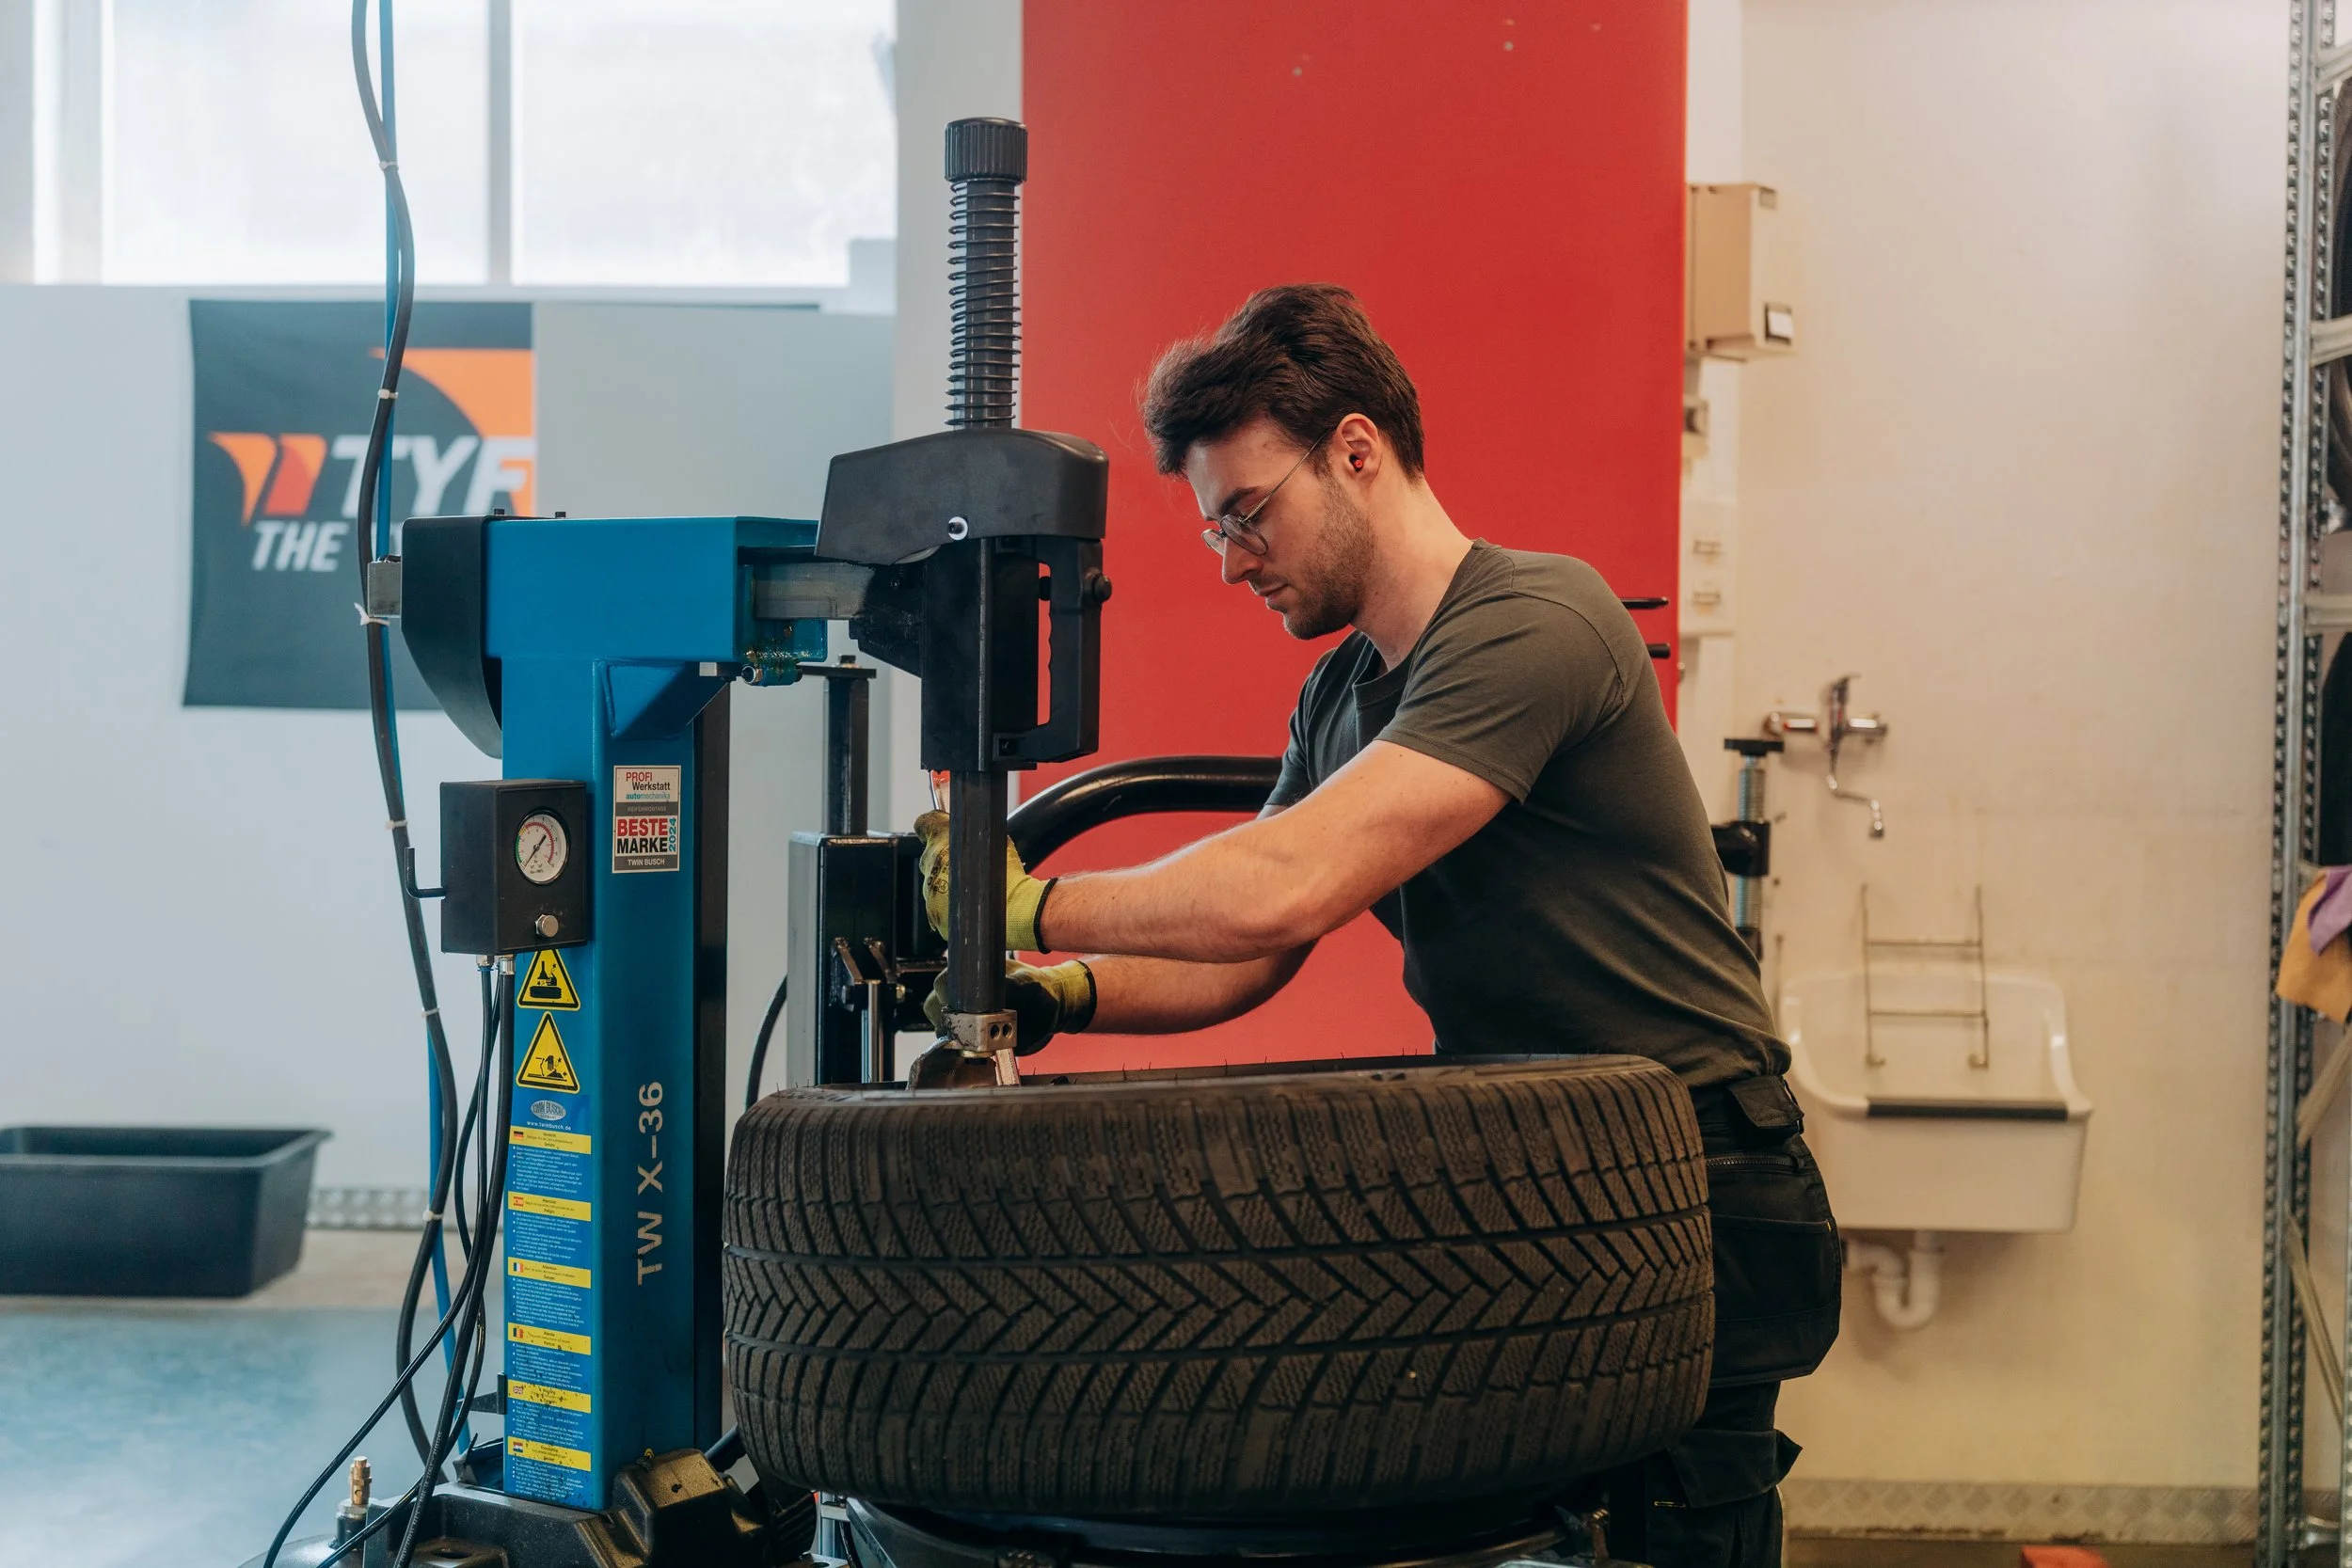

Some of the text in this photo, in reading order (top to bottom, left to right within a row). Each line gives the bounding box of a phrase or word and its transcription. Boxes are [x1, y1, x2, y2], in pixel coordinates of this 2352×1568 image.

[251, 520, 349, 573] THE
[626, 771, 653, 782] PROFI
[632, 782, 671, 791] Werkstatt
[626, 792, 671, 800] automechanika
[617, 817, 668, 837] BESTE
[616, 837, 668, 854] MARKE
[637, 1082, 663, 1286] TW X-36
